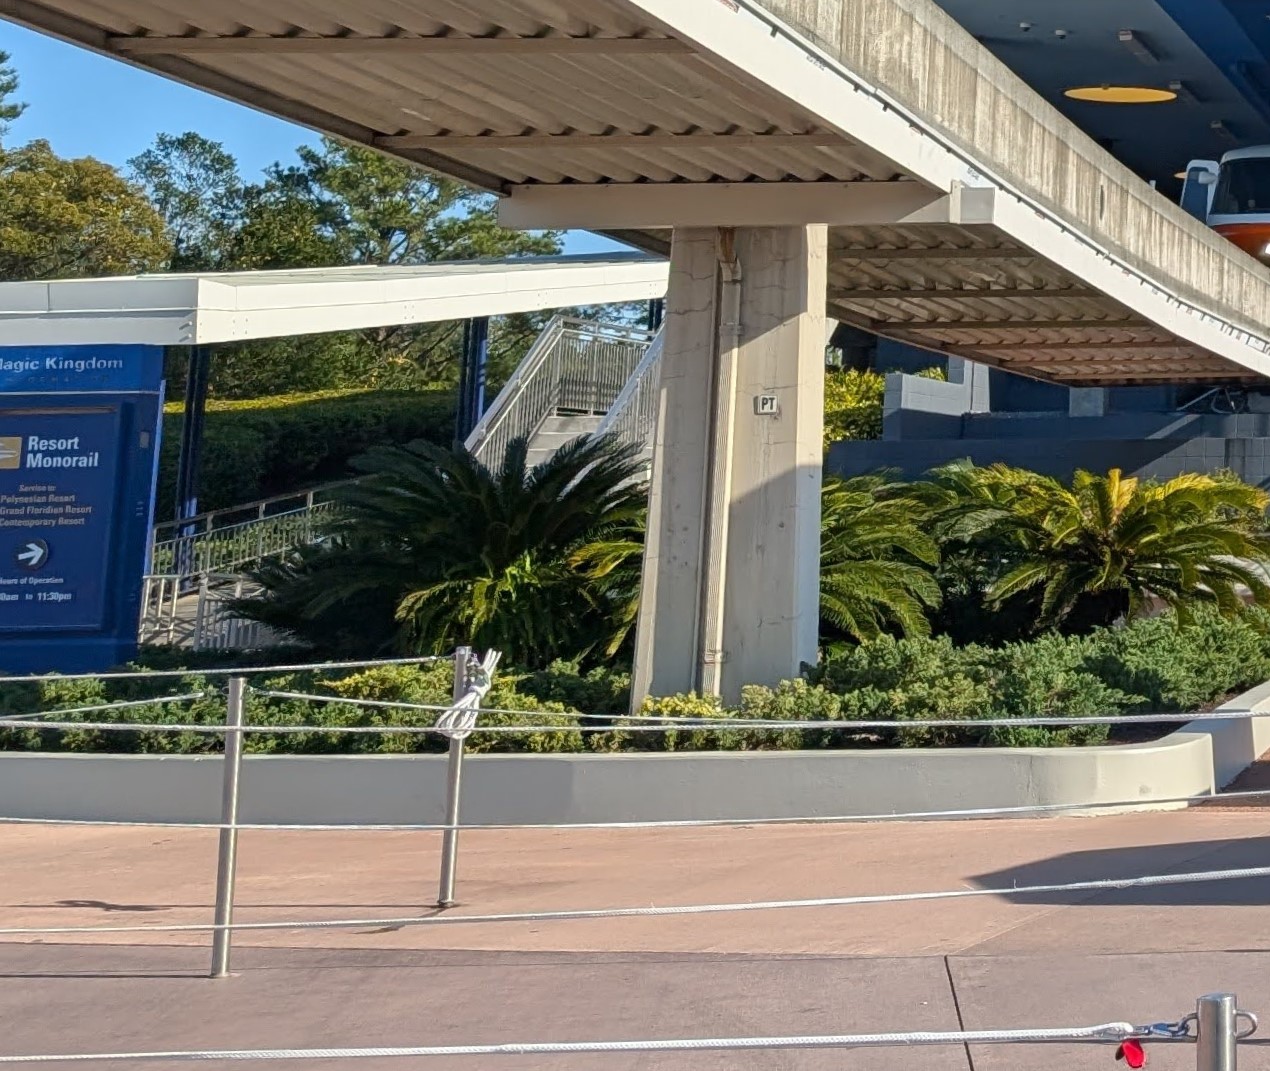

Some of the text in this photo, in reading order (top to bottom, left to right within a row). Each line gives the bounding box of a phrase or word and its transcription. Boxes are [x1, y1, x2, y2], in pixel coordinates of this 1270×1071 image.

[0, 356, 123, 373] agic Kingdom
[761, 397, 775, 410] PT
[28, 436, 79, 451] Resort
[26, 452, 99, 468] Monorail
[1, 494, 75, 504] Polynesian Resort
[26, 505, 63, 515] Floridian
[65, 505, 92, 513] Resort
[58, 517, 85, 525] Resort
